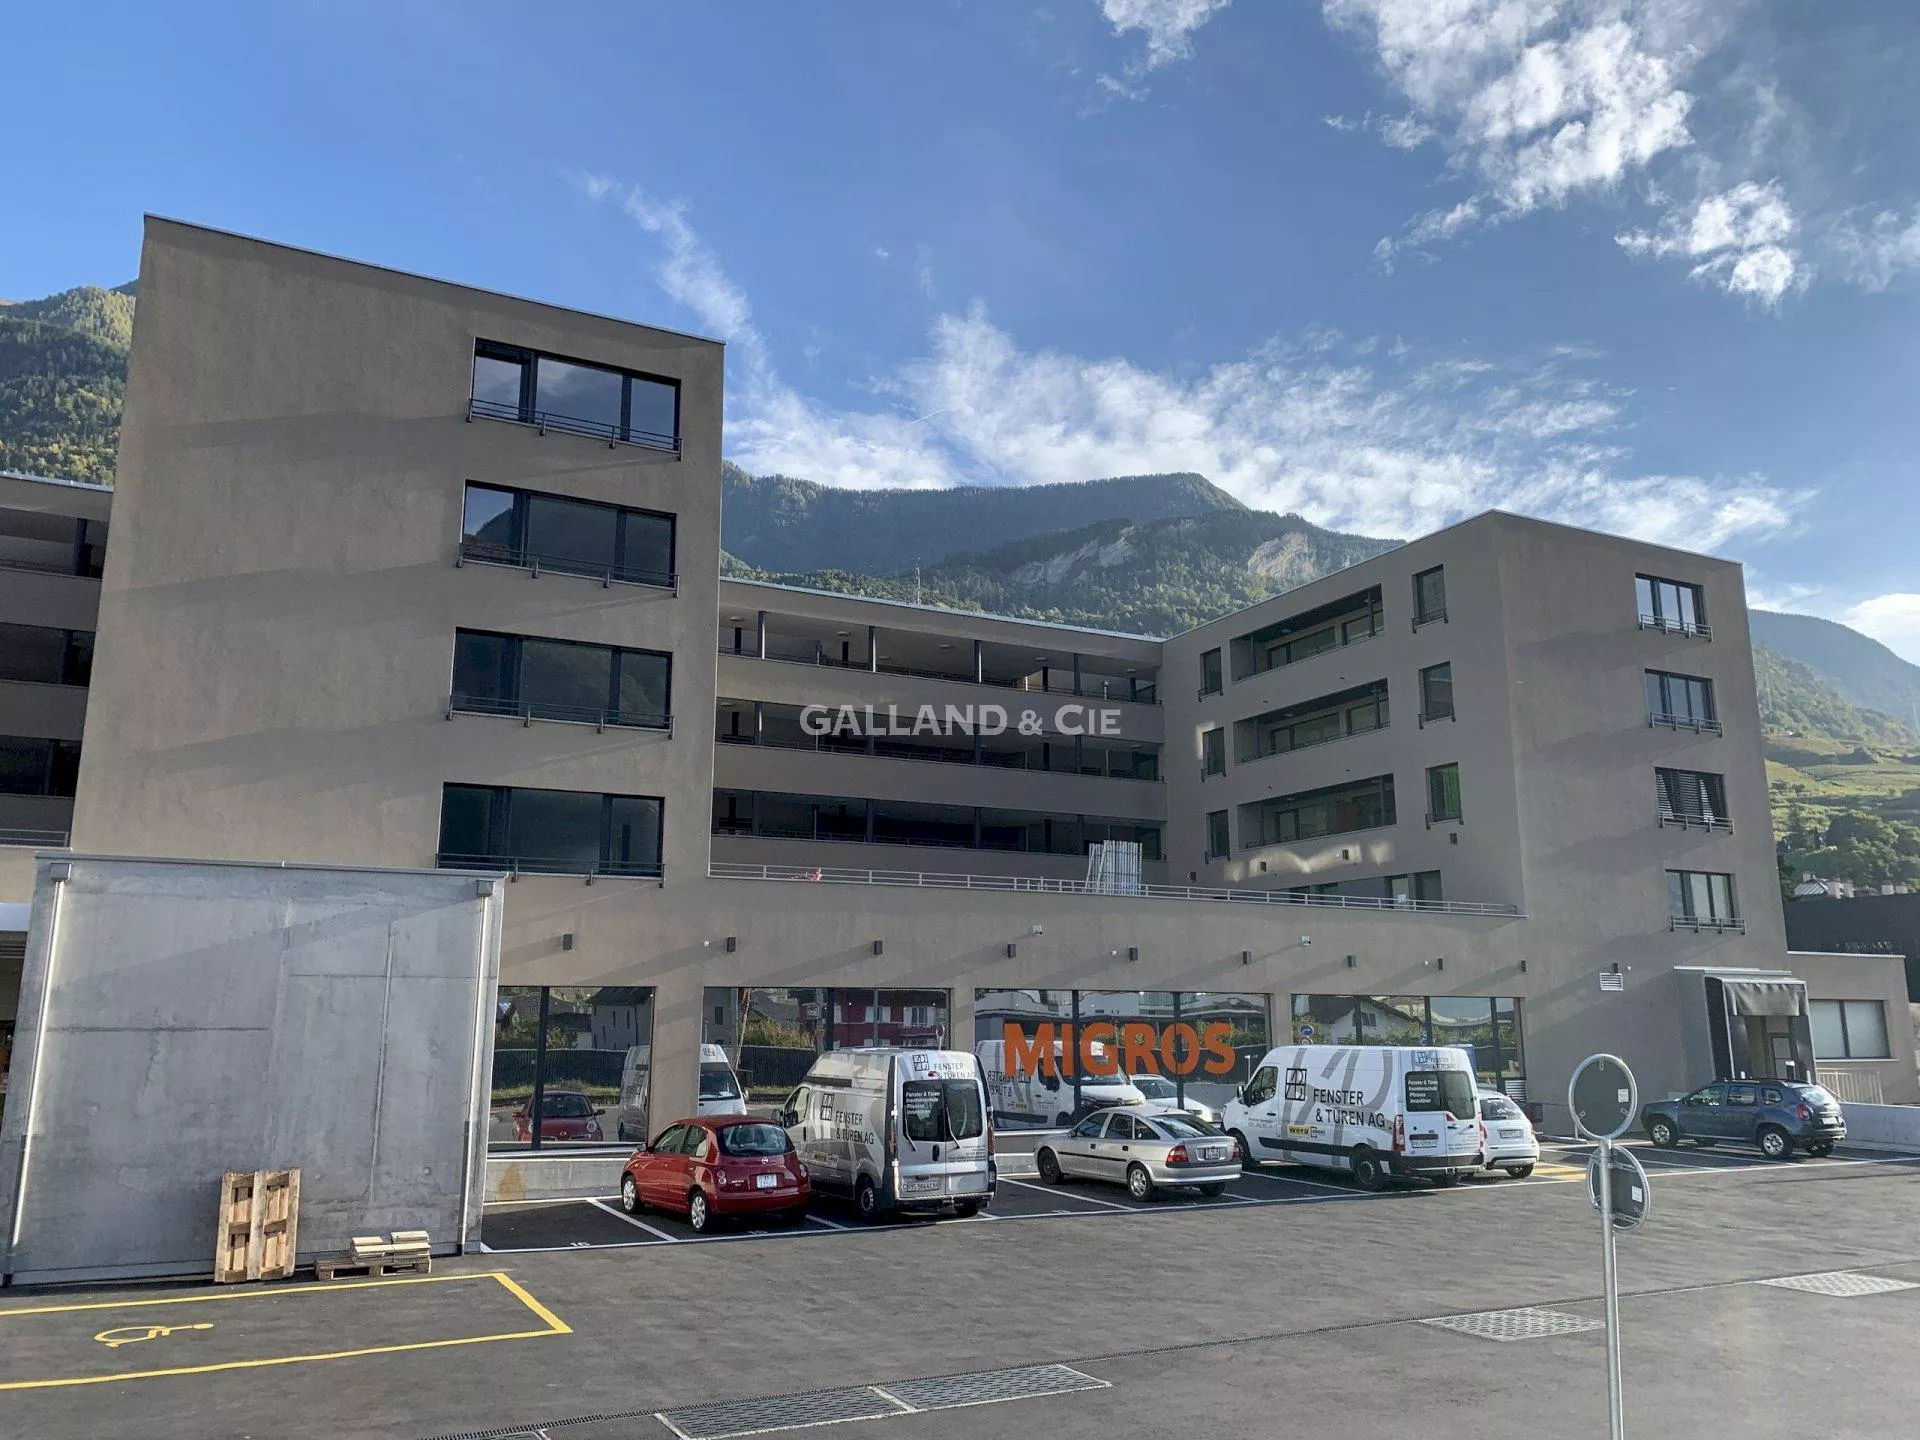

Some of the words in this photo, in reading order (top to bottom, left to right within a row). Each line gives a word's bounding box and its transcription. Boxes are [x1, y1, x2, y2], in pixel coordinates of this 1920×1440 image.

[1003, 1022, 1236, 1077] MIGROS
[934, 1062, 964, 1070] FENSTER
[1313, 1089, 1364, 1105] FENSTER
[836, 1111, 863, 1126] FENSTER
[1316, 1109, 1323, 1122] &
[1325, 1107, 1364, 1126] TÜREN
[1368, 1112, 1385, 1127] AG
[836, 1127, 840, 1140] &
[841, 1127, 863, 1143] TÜREN
[864, 1132, 874, 1144] AG
[1289, 1126, 1309, 1134] weru
